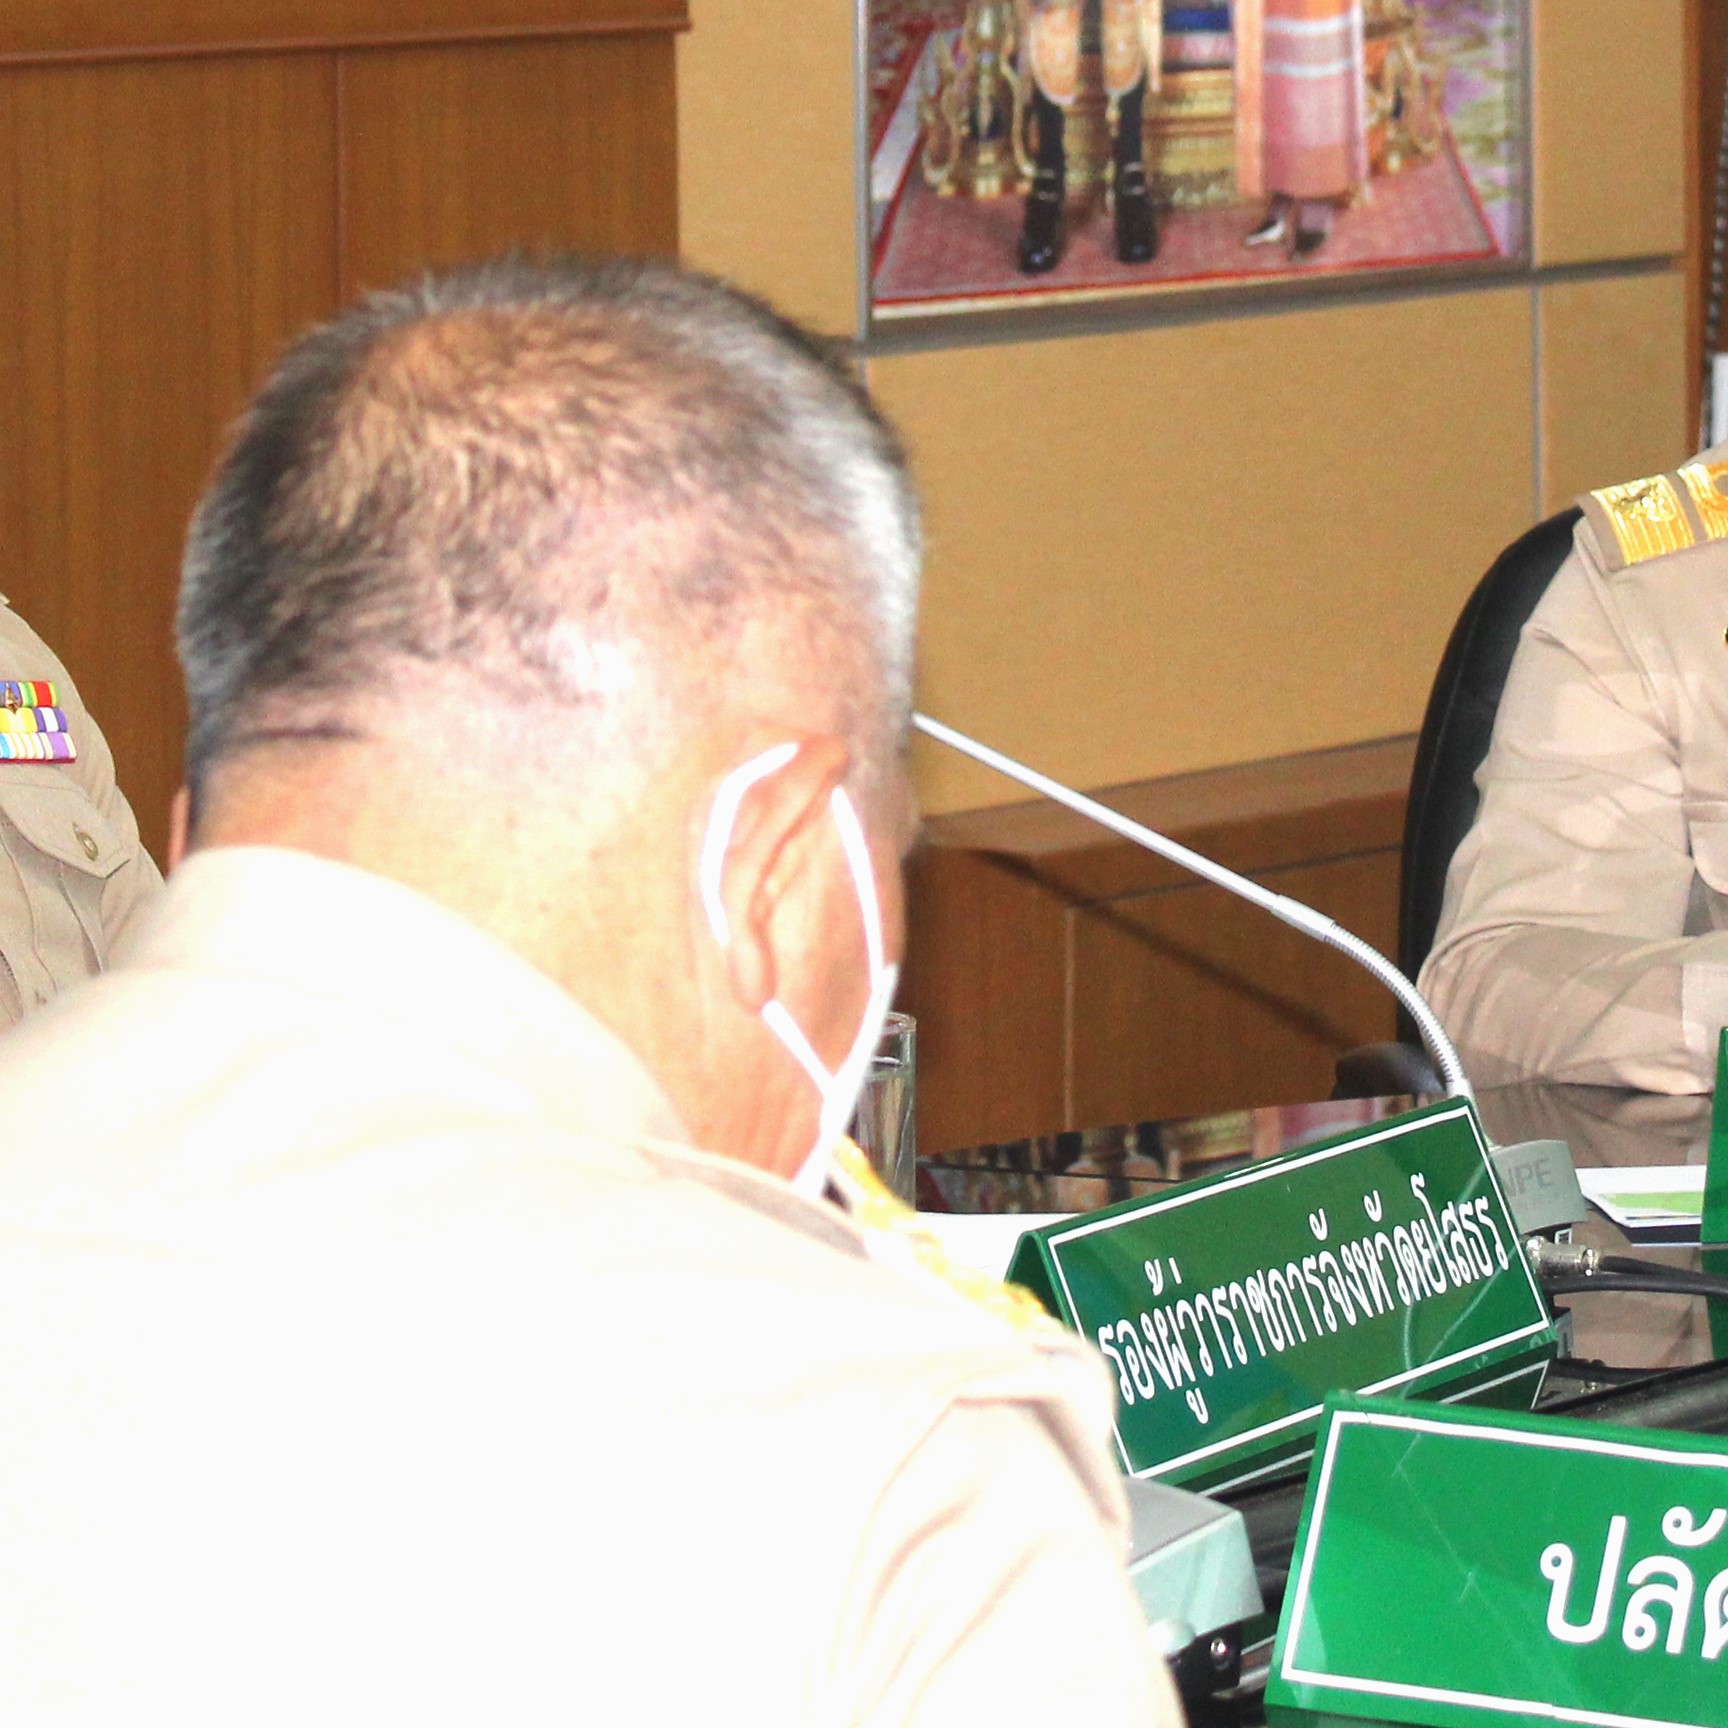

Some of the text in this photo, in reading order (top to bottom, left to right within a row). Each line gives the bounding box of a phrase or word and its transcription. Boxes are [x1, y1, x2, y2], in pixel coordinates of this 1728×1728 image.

[1097, 1173, 1510, 1425] รองผู้ว่าราชการจังหวัดยโสธร
